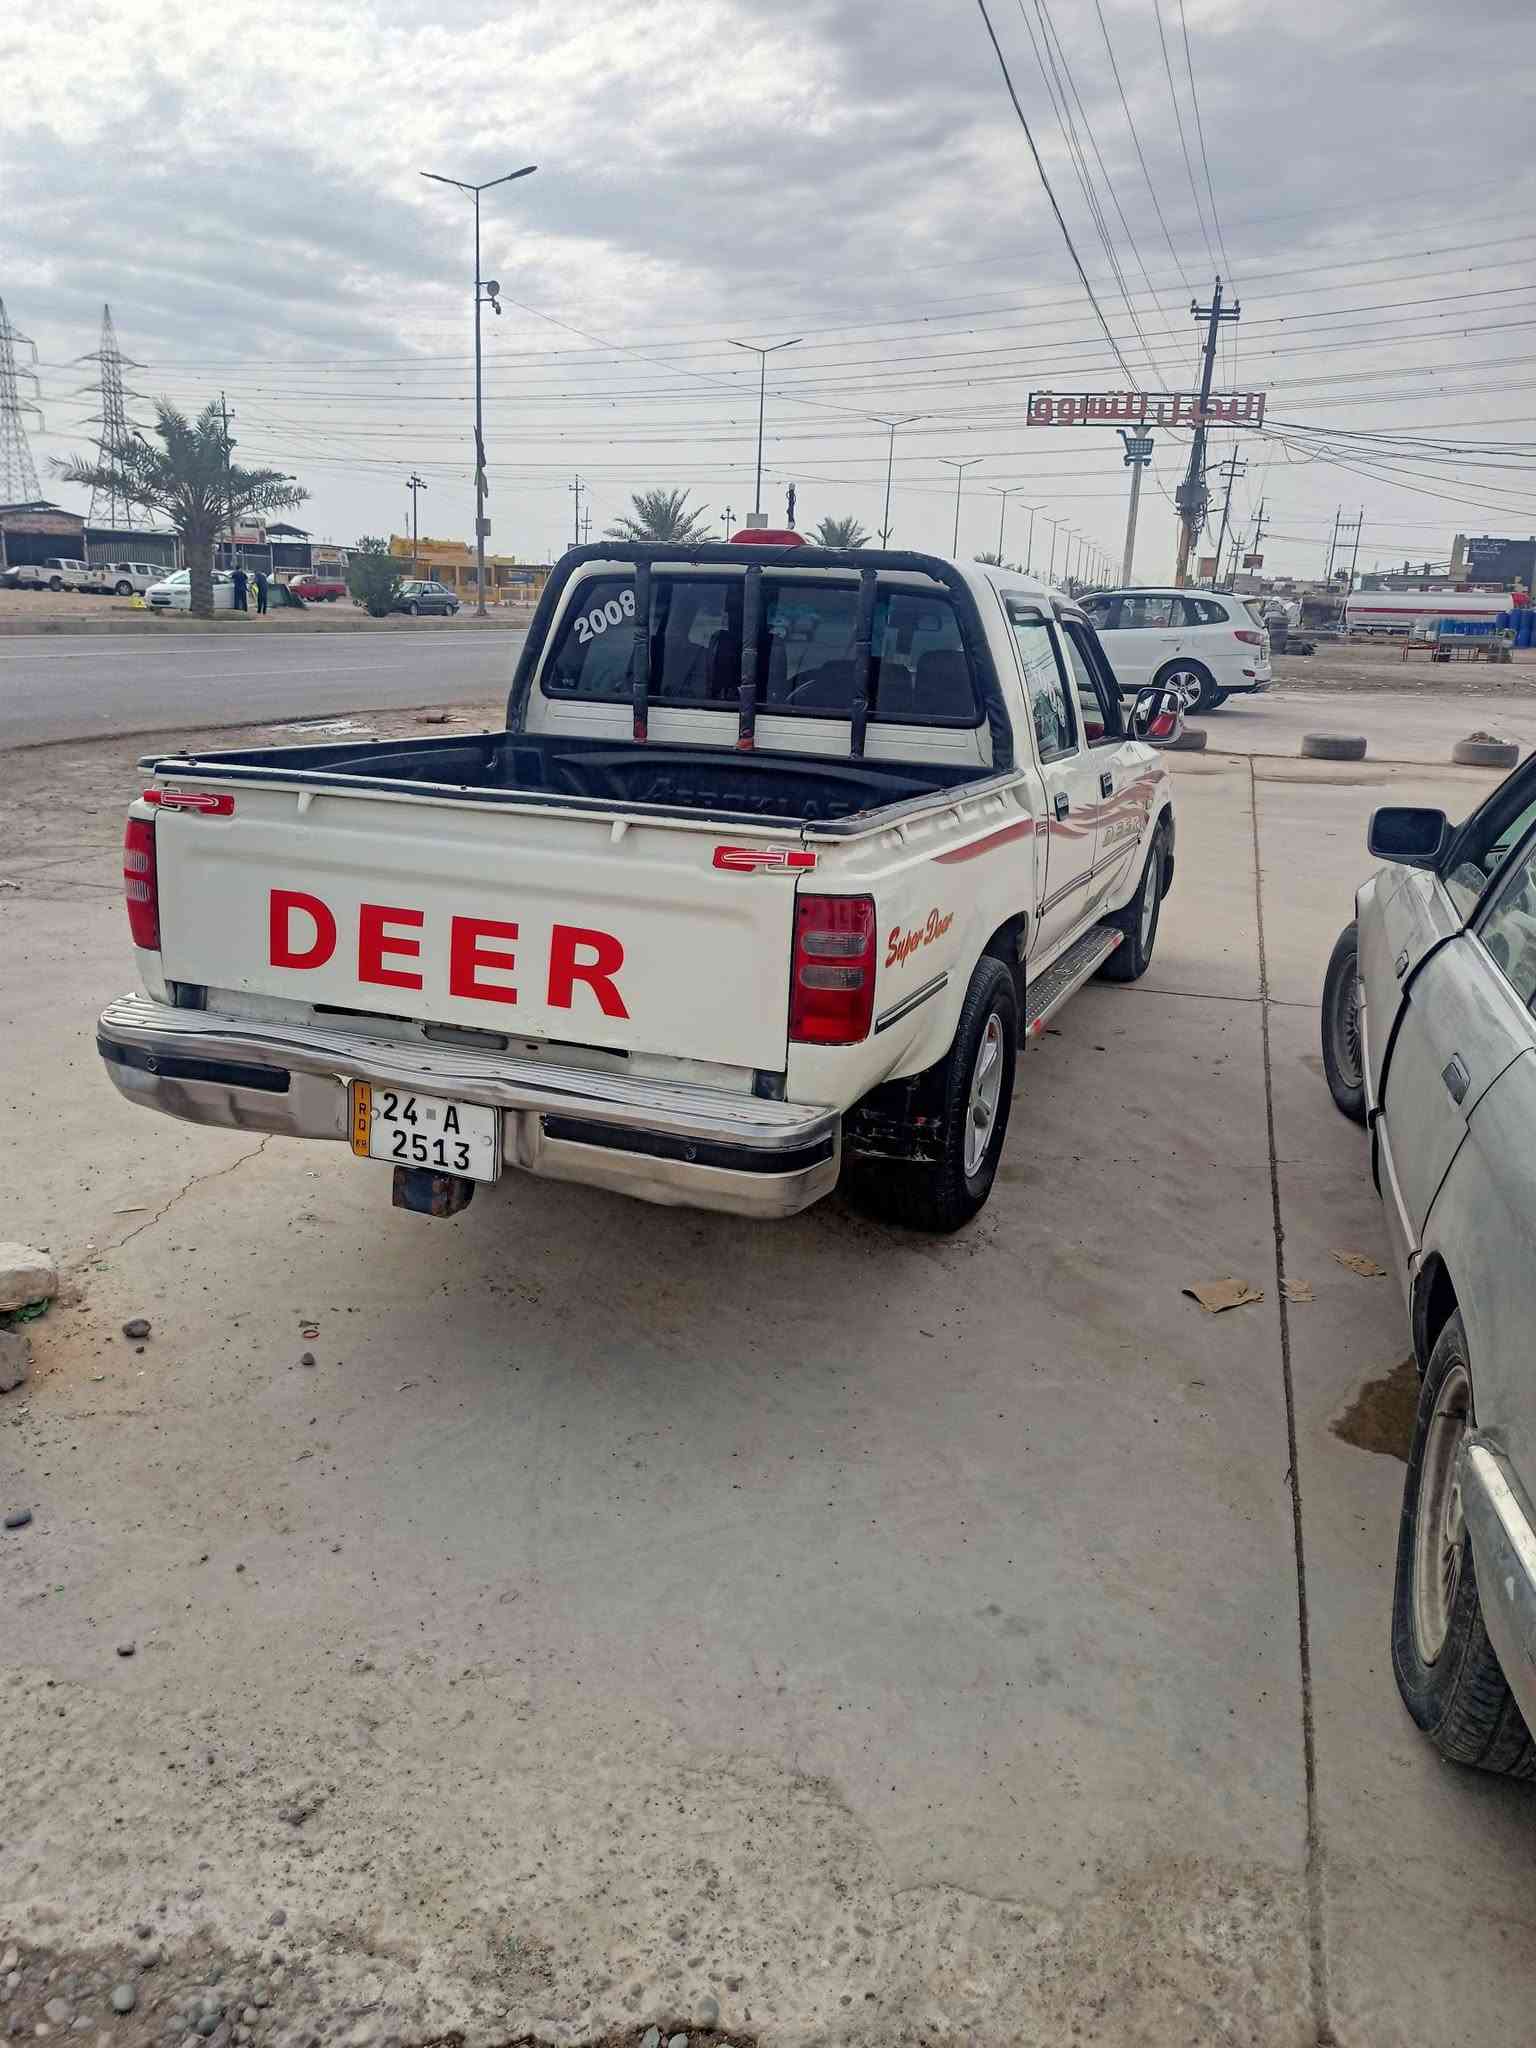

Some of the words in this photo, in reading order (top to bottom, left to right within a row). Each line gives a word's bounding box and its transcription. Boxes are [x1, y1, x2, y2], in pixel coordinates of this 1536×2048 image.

[1027, 390, 1149, 426] للتسوق
[573, 589, 637, 644] 2008
[269, 889, 630, 1018] DEER
[885, 926, 925, 968] Super
[383, 1092, 418, 1126] 24
[443, 1105, 460, 1134] A
[392, 1129, 470, 1171] 2513
